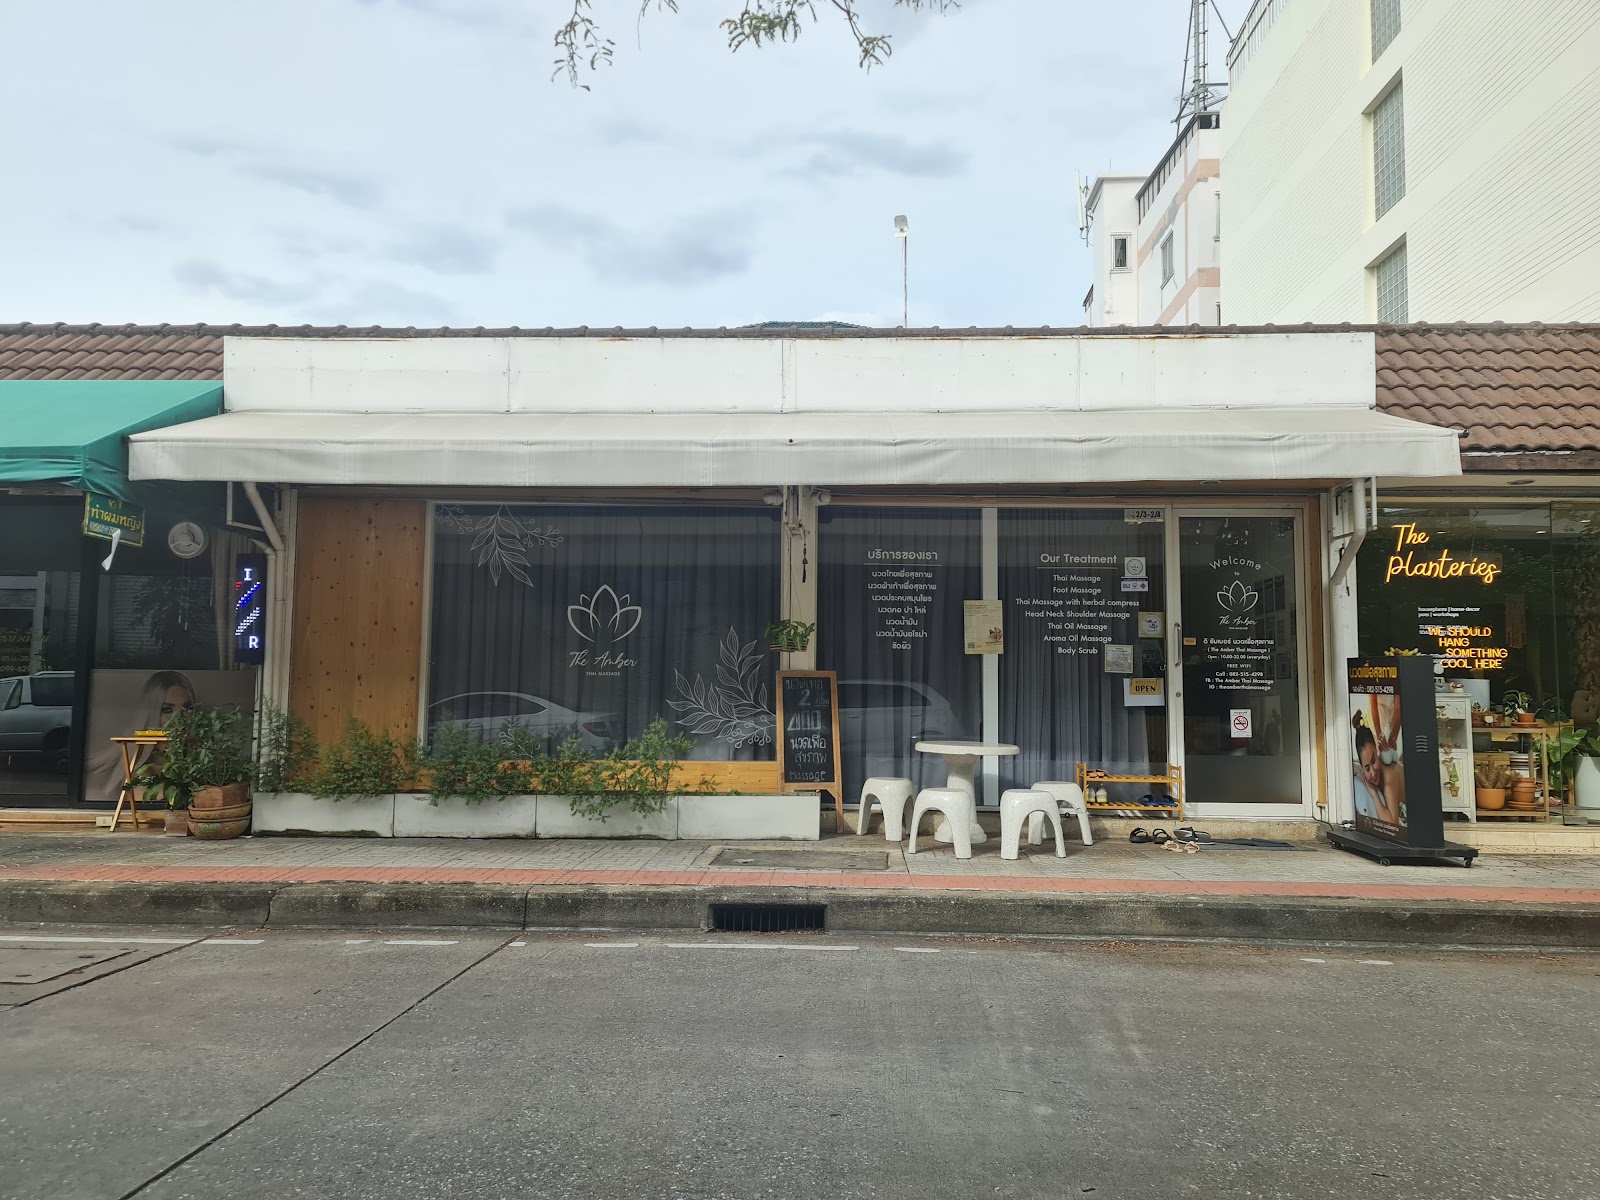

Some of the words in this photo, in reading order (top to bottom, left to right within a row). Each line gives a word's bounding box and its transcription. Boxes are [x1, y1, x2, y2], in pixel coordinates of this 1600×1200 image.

[1390, 522, 1430, 552] The
[867, 548, 938, 560] บริการของเรา
[1040, 553, 1061, 564] Our
[1063, 553, 1118, 564] Treatment
[1209, 555, 1262, 570] Welcome
[871, 568, 933, 579] นวดไทยเพื่อสุขภาพ
[1053, 574, 1068, 582] Thai
[1070, 575, 1102, 584] Massage
[1052, 586, 1068, 594] Foot
[1070, 586, 1102, 595] Massage
[1032, 598, 1064, 608] Massage
[1082, 598, 1106, 606] herbal
[1107, 600, 1140, 608] compress
[1025, 610, 1045, 618] Head
[1046, 610, 1065, 618] Neck
[1066, 610, 1097, 618] Shoulder
[1098, 611, 1131, 620] Massage
[1219, 615, 1231, 625] The
[1233, 616, 1258, 626] Amber
[1047, 622, 1063, 630] Thai
[1064, 622, 1075, 630] Oil
[1076, 622, 1108, 632] Massage
[1427, 627, 1445, 636] WE
[1448, 627, 1492, 637] SHOULD
[1043, 634, 1067, 642] Aroma
[1068, 634, 1079, 642] Oil
[1080, 635, 1113, 644] Massage
[1438, 638, 1470, 647] HANG
[1057, 646, 1077, 656] Body
[1078, 646, 1098, 654] Scrub
[1445, 648, 1509, 658] SOMETHING
[569, 649, 589, 668] The
[593, 650, 638, 668] Amber
[1440, 659, 1473, 669] COOL
[1474, 659, 1503, 669] HERE
[1349, 660, 1398, 682] นวดเพื่อสุขภาพ
